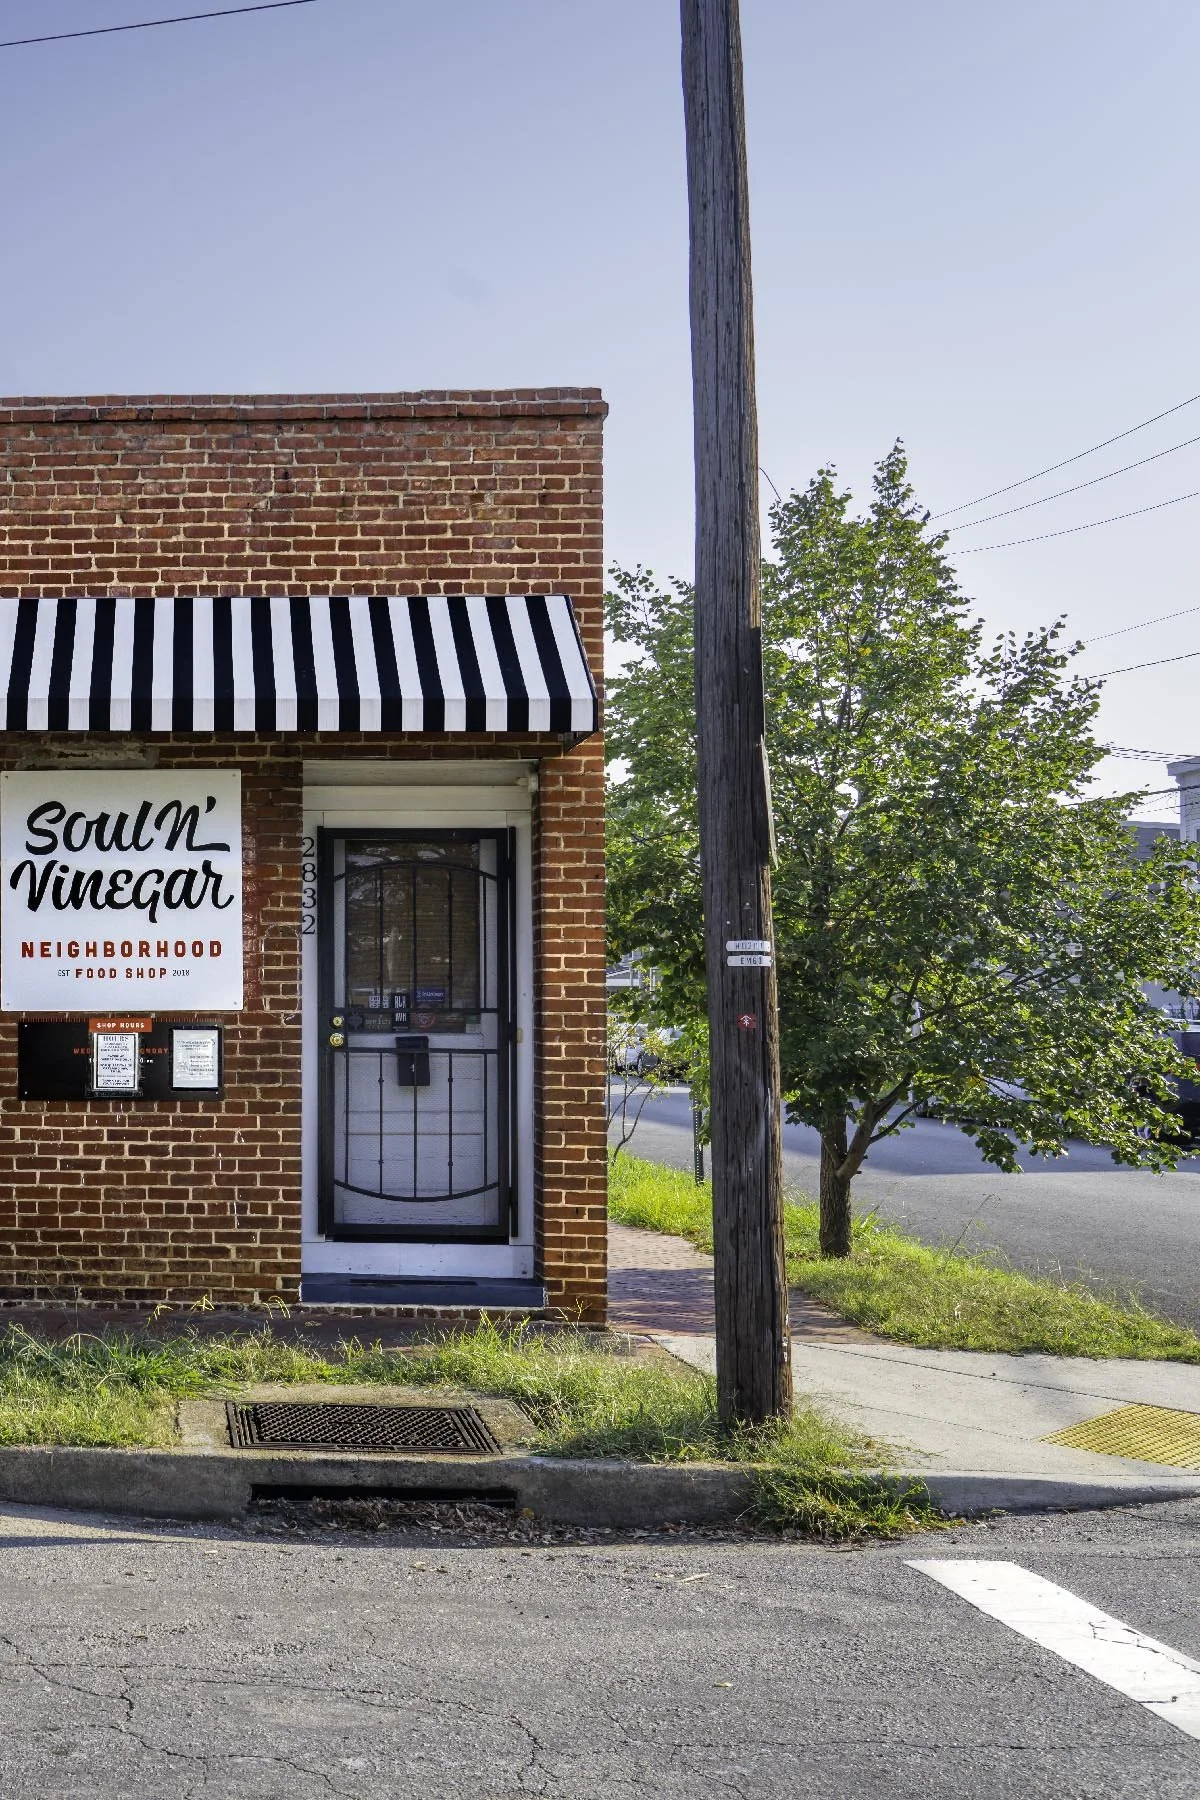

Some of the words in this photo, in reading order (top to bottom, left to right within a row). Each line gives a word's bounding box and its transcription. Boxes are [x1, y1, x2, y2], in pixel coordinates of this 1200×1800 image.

[25, 800, 154, 855] Soul
[154, 796, 230, 852] N'
[10, 860, 234, 923] Vinegar
[302, 837, 317, 934] 2832
[21, 940, 222, 958] NEIGHBORHOOD
[58, 969, 70, 977] EST
[75, 968, 117, 979] FOOD
[125, 968, 167, 979] SHOP
[172, 969, 190, 977] 2018
